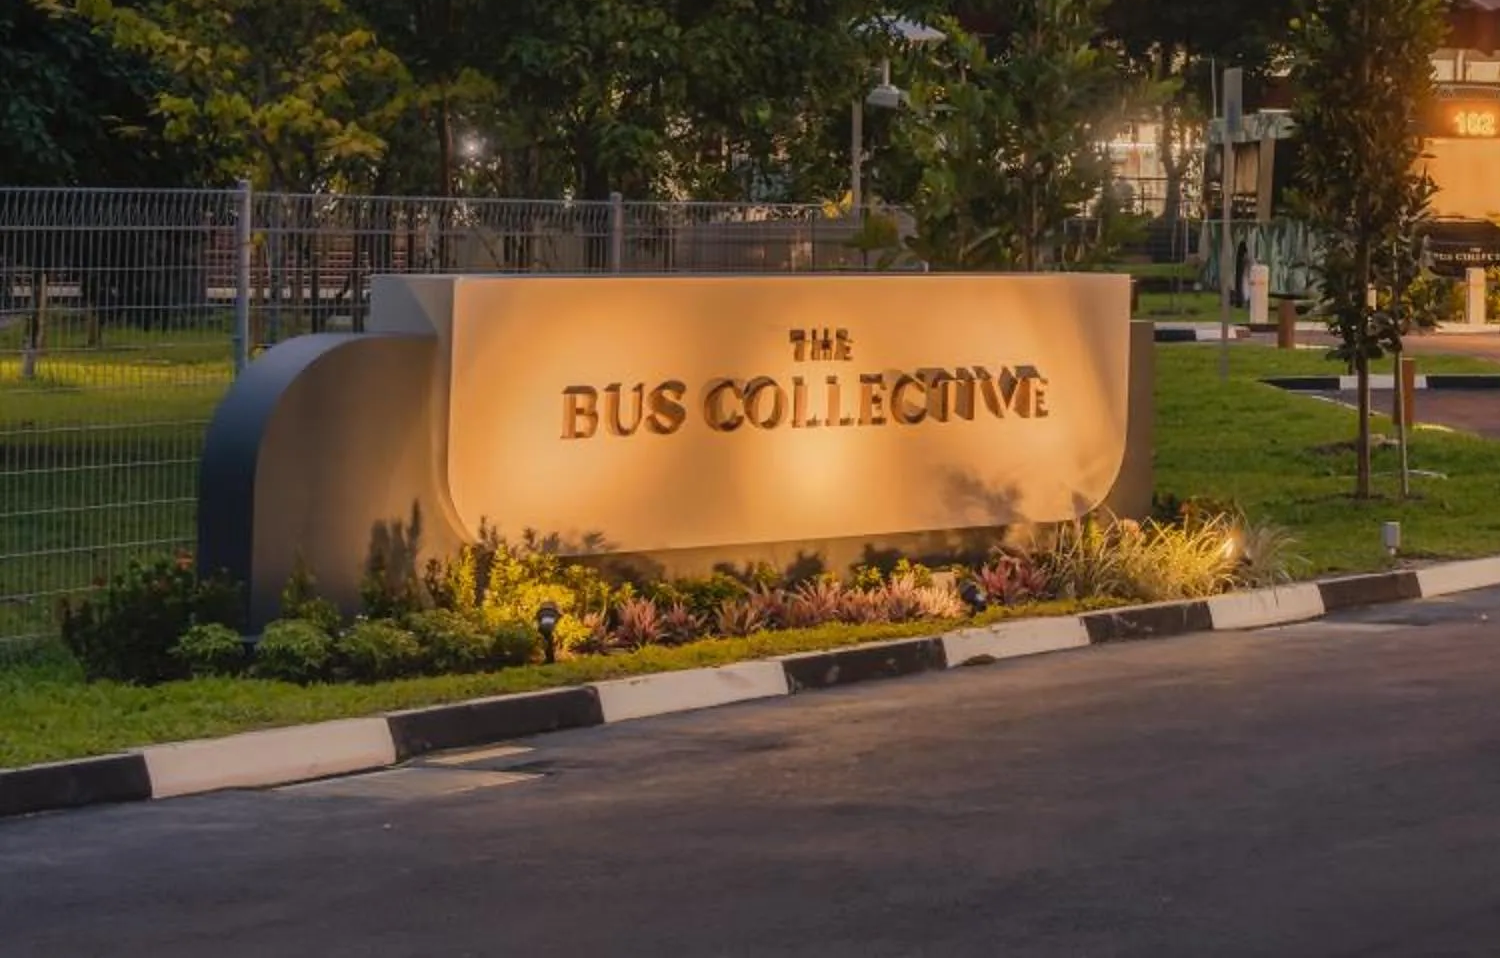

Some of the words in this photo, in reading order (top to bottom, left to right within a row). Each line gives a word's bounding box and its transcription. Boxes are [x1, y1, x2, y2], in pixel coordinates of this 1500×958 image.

[789, 329, 853, 362] THE
[560, 379, 687, 440] BUS
[703, 364, 1049, 432] COLLECTIVE
